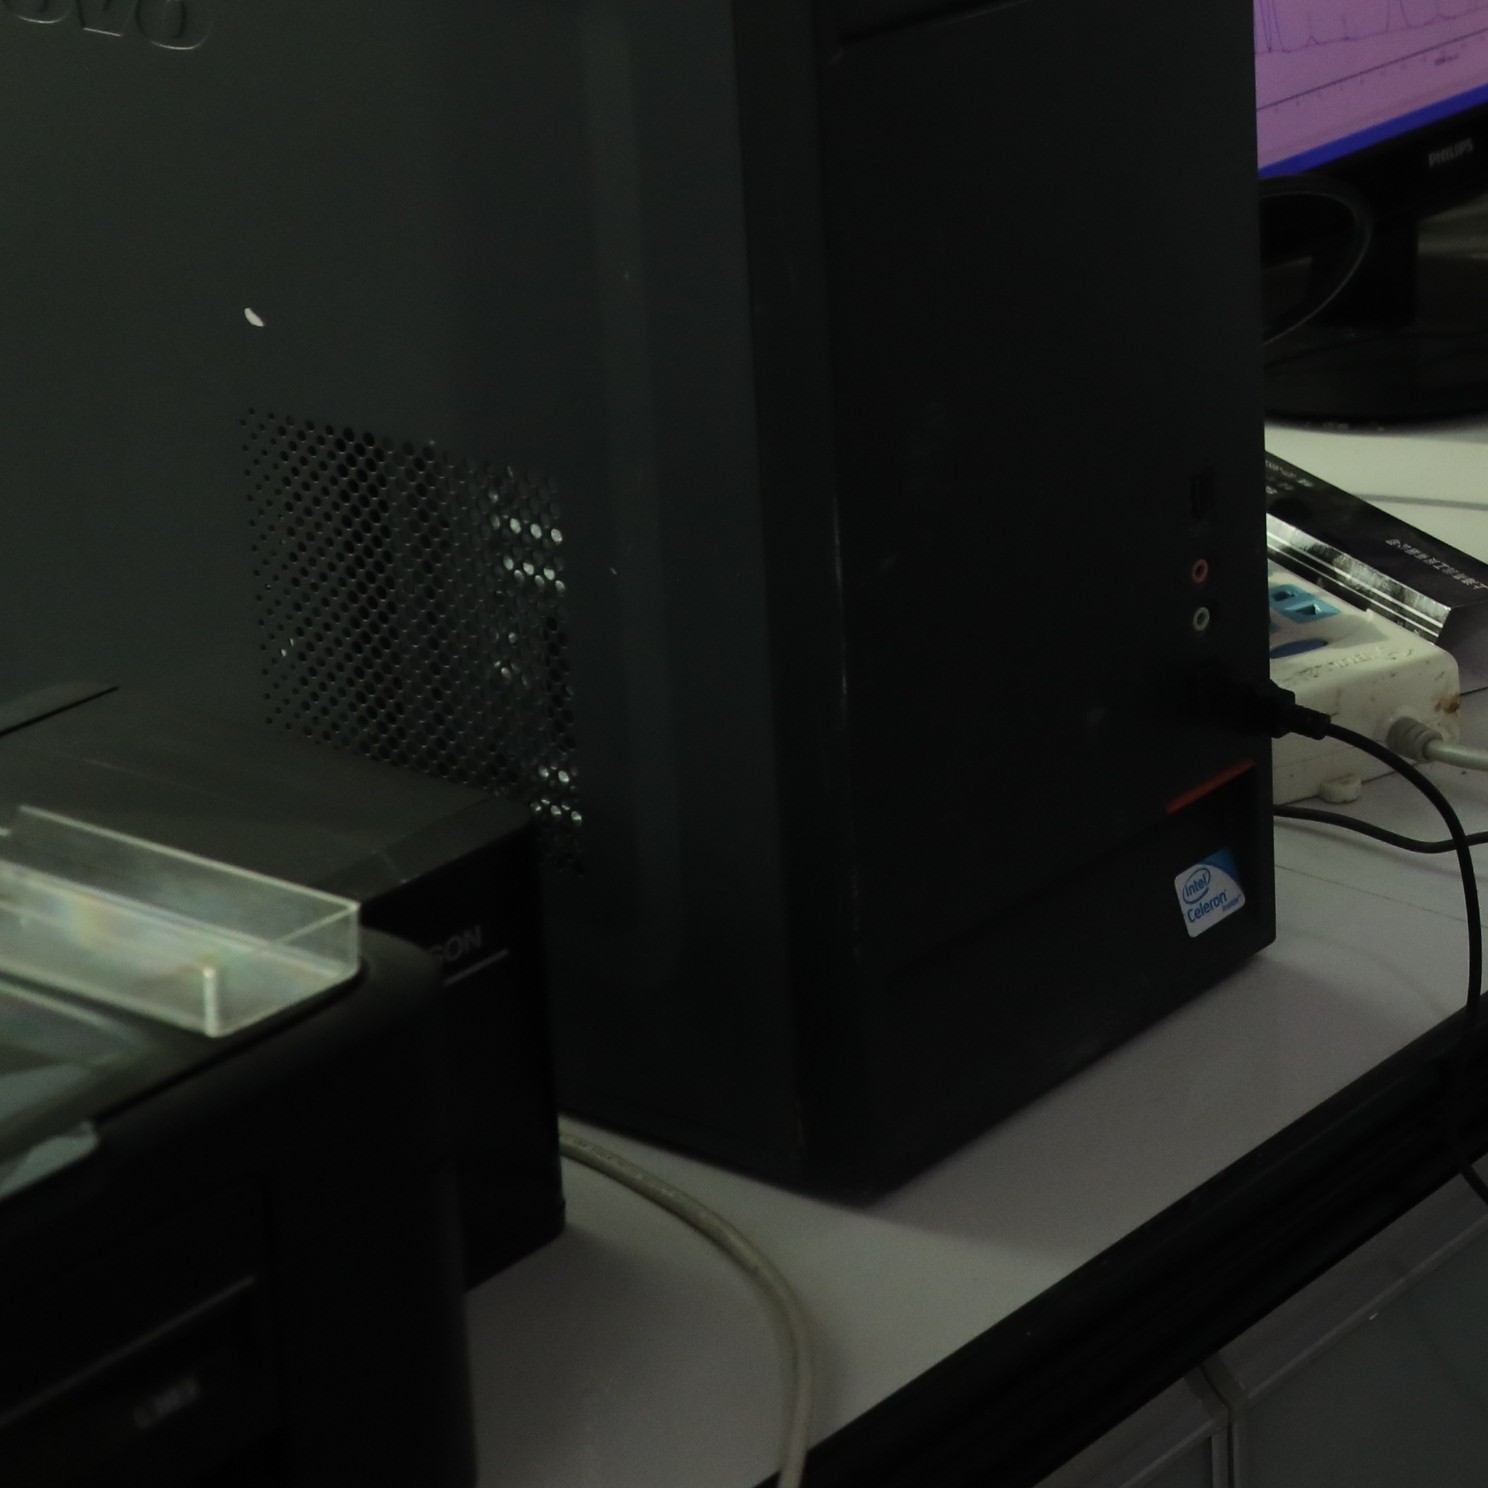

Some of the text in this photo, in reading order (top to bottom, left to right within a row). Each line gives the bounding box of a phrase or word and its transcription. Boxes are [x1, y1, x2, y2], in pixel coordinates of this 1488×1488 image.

[1428, 136, 1474, 169] PHILIPS
[1184, 872, 1208, 898] intel
[1187, 890, 1228, 923] Celeron
